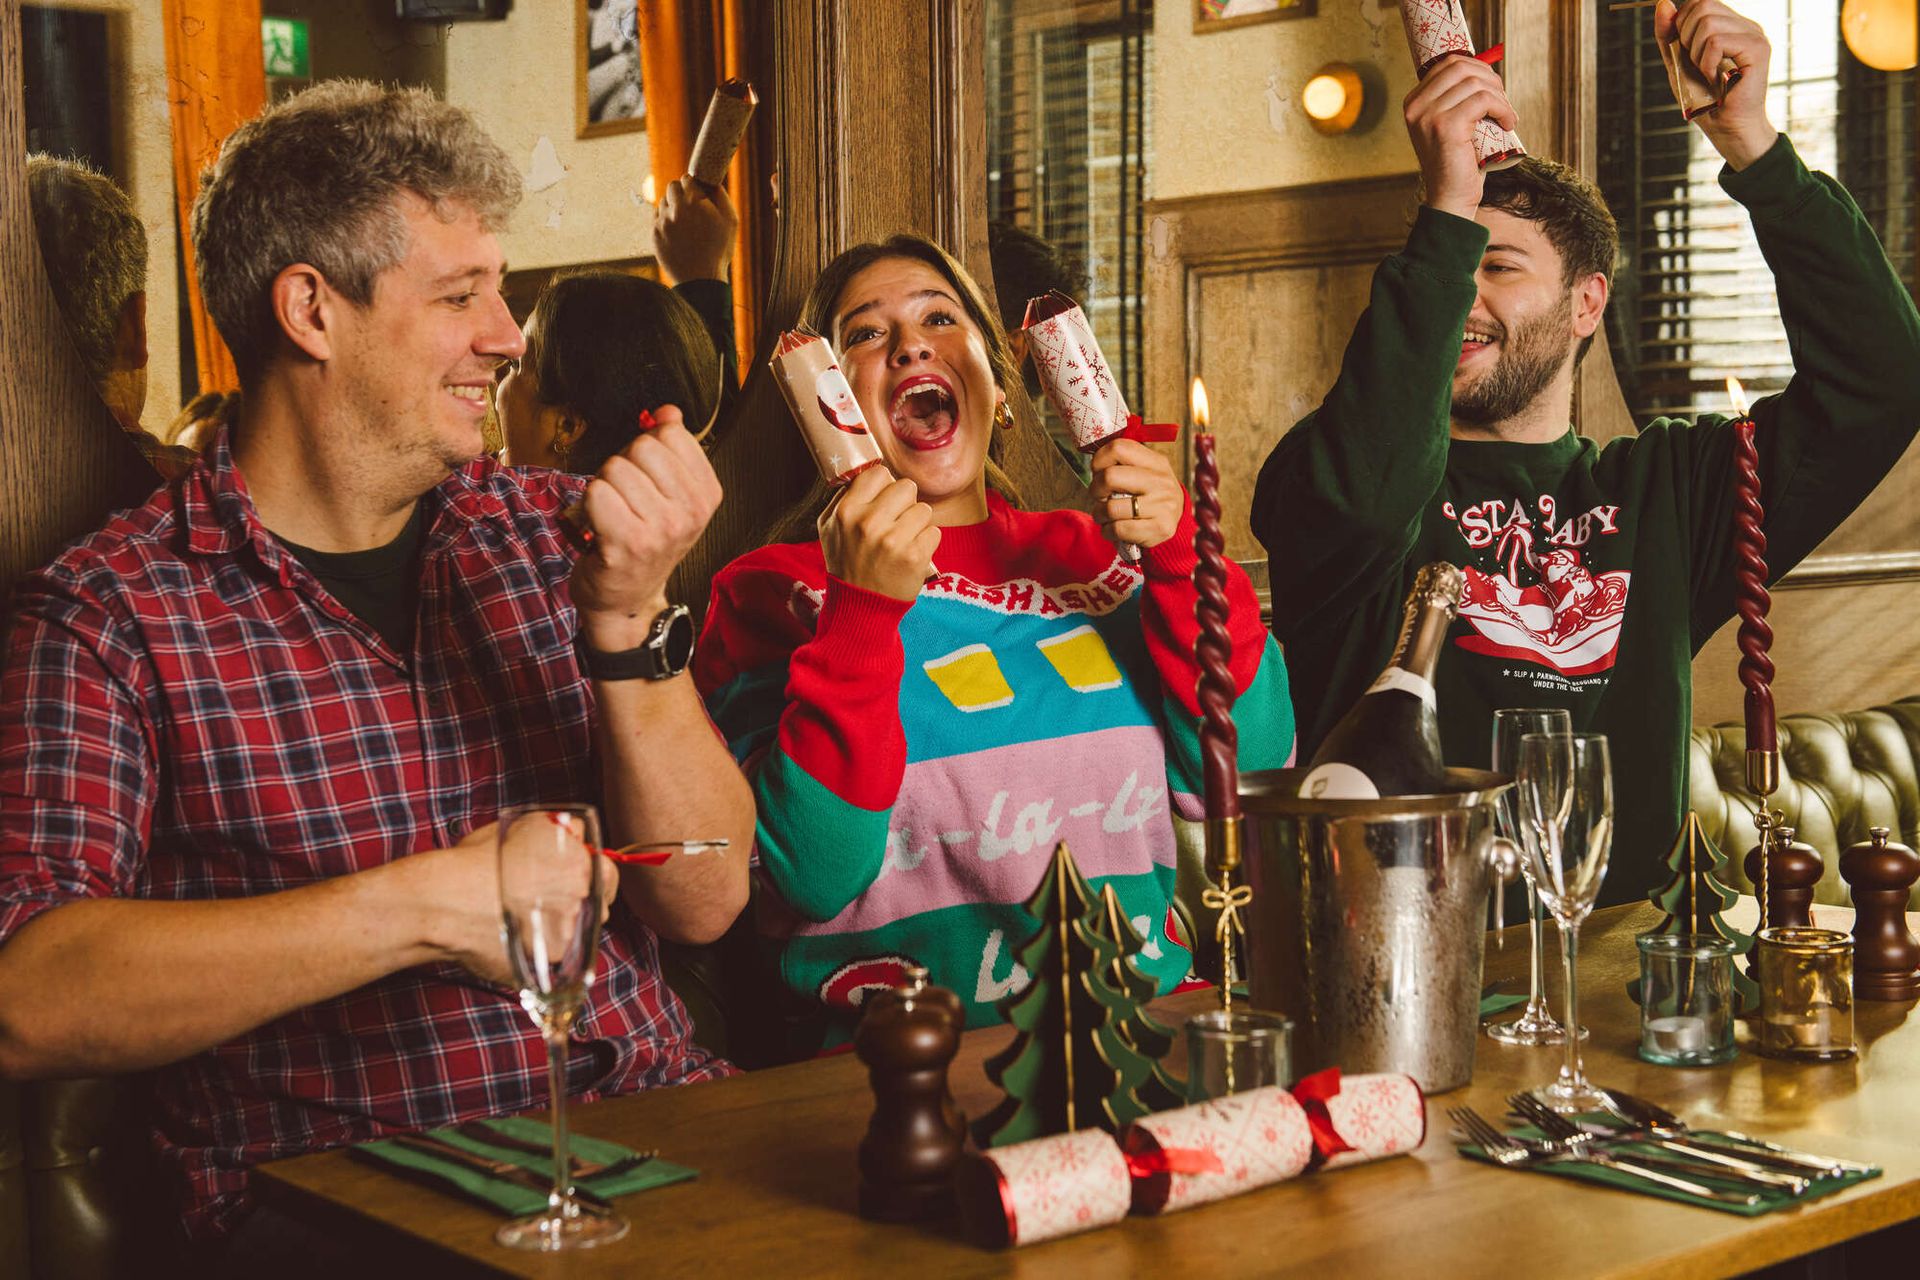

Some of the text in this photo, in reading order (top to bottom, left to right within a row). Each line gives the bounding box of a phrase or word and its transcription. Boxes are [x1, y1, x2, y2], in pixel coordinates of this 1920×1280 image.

[1513, 670, 1528, 678] SLIP
[1529, 671, 1535, 679] A
[1533, 680, 1555, 689] UNDER
[1556, 682, 1568, 691] THE
